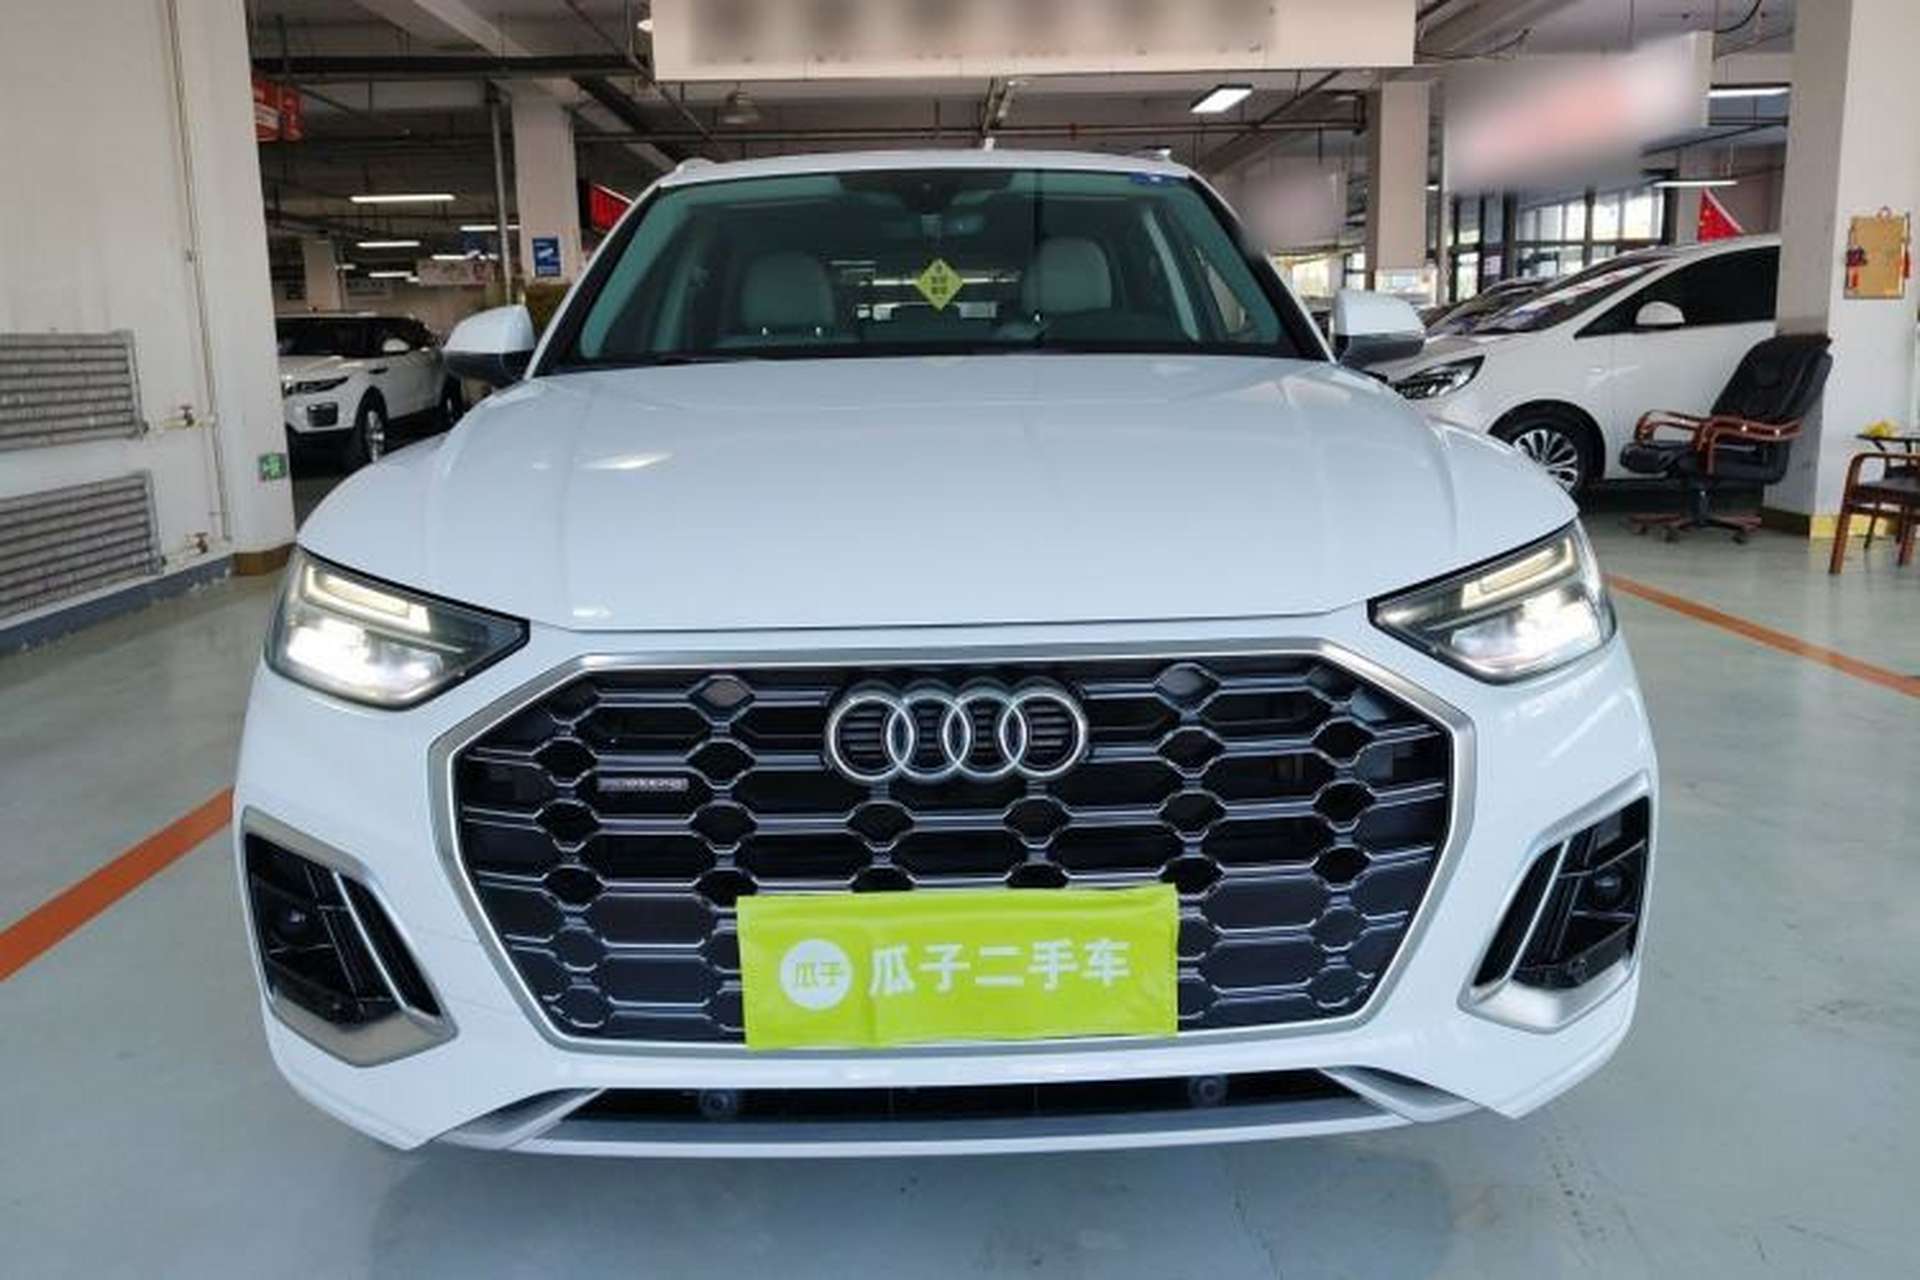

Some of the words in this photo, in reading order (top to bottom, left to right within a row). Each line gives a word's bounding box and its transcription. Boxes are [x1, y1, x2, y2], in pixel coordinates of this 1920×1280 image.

[793, 960, 843, 988] 瓜子
[869, 938, 1131, 997] 瓜子二手车
